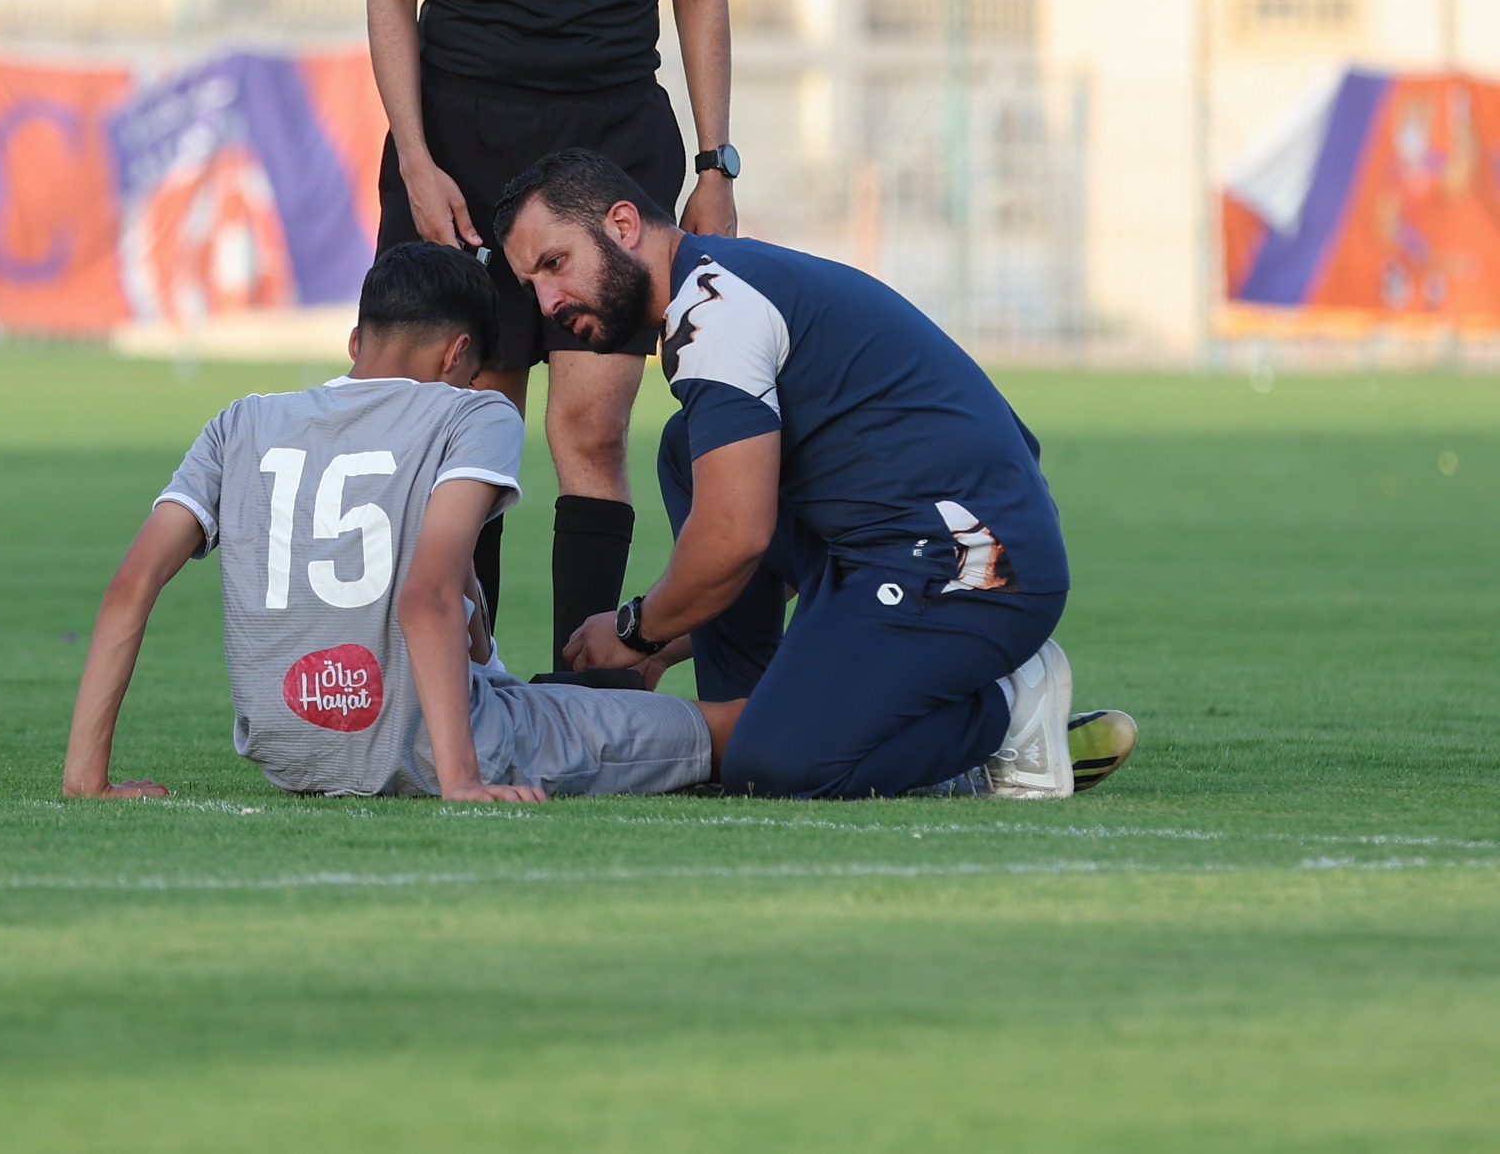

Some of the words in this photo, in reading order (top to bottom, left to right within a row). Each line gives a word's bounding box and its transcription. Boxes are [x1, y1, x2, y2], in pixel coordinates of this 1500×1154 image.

[259, 447, 398, 610] 15
[298, 672, 372, 716] Hayat
[320, 658, 369, 688] حياة
